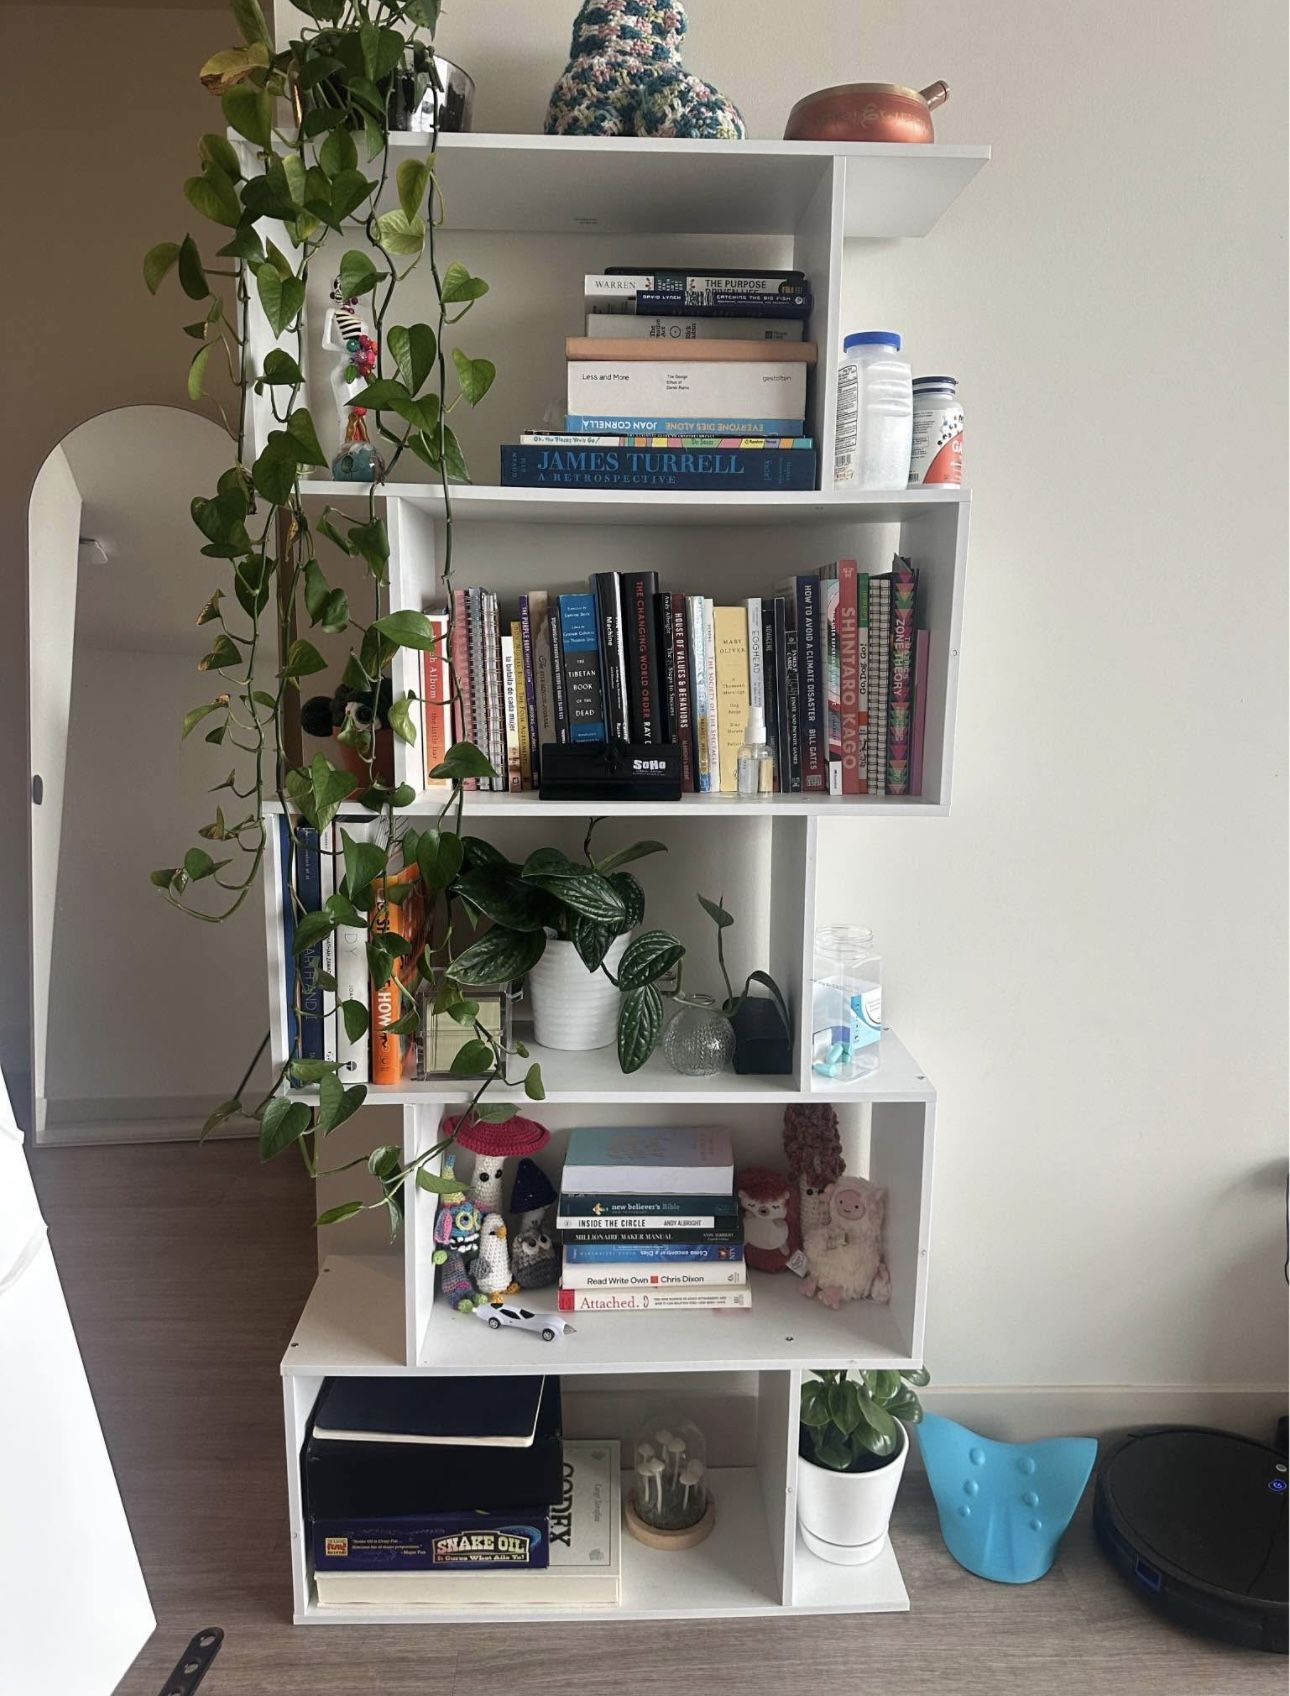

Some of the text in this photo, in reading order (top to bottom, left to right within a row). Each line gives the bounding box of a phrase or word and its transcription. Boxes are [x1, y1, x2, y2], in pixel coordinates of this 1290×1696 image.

[595, 281, 636, 289] WARREN
[705, 280, 767, 289] THE PURPOSE
[582, 420, 658, 430] JOAN CORNELLA
[665, 422, 764, 432] EVERYONE DIES ALONE
[538, 450, 744, 474] JAMES TURRELL
[554, 474, 676, 484] RETROSPECTIVE
[635, 581, 644, 597] THE
[804, 584, 812, 603] HOW
[804, 605, 812, 616] TO
[522, 616, 530, 638] PURPLE
[606, 616, 614, 646] Machine
[636, 599, 646, 652] CHANGING
[674, 612, 684, 637] HOUSE
[805, 617, 814, 641] AVOID
[676, 639, 684, 648] OF
[752, 630, 760, 674] EGGHEAD
[676, 650, 686, 678] VALUES
[806, 650, 814, 682] CLIMATE
[894, 618, 904, 696] ZONE THEORY
[568, 670, 596, 678] TIBETAN
[639, 655, 648, 686] WORLD
[428, 666, 437, 699] Albom
[507, 687, 514, 696] de
[842, 607, 856, 769] SHINTARO KAGO
[642, 689, 651, 718] ORDER
[679, 688, 688, 728] BEHAVIORS
[710, 703, 715, 711] OF
[806, 684, 816, 721] DISASTER
[508, 713, 516, 732] mujer
[808, 728, 816, 744] BILL
[809, 746, 818, 770] GATES
[378, 992, 392, 1026] HOW
[662, 1202, 680, 1210] Bible
[578, 1220, 602, 1228] INSIDE
[620, 1219, 646, 1227] CIRCLE
[608, 1276, 630, 1284] Write
[630, 1276, 648, 1284] Own
[660, 1275, 680, 1283] Chris
[580, 1296, 640, 1309] Attached.
[436, 1535, 494, 1554] SNAKE
[498, 1536, 524, 1553] OIL
